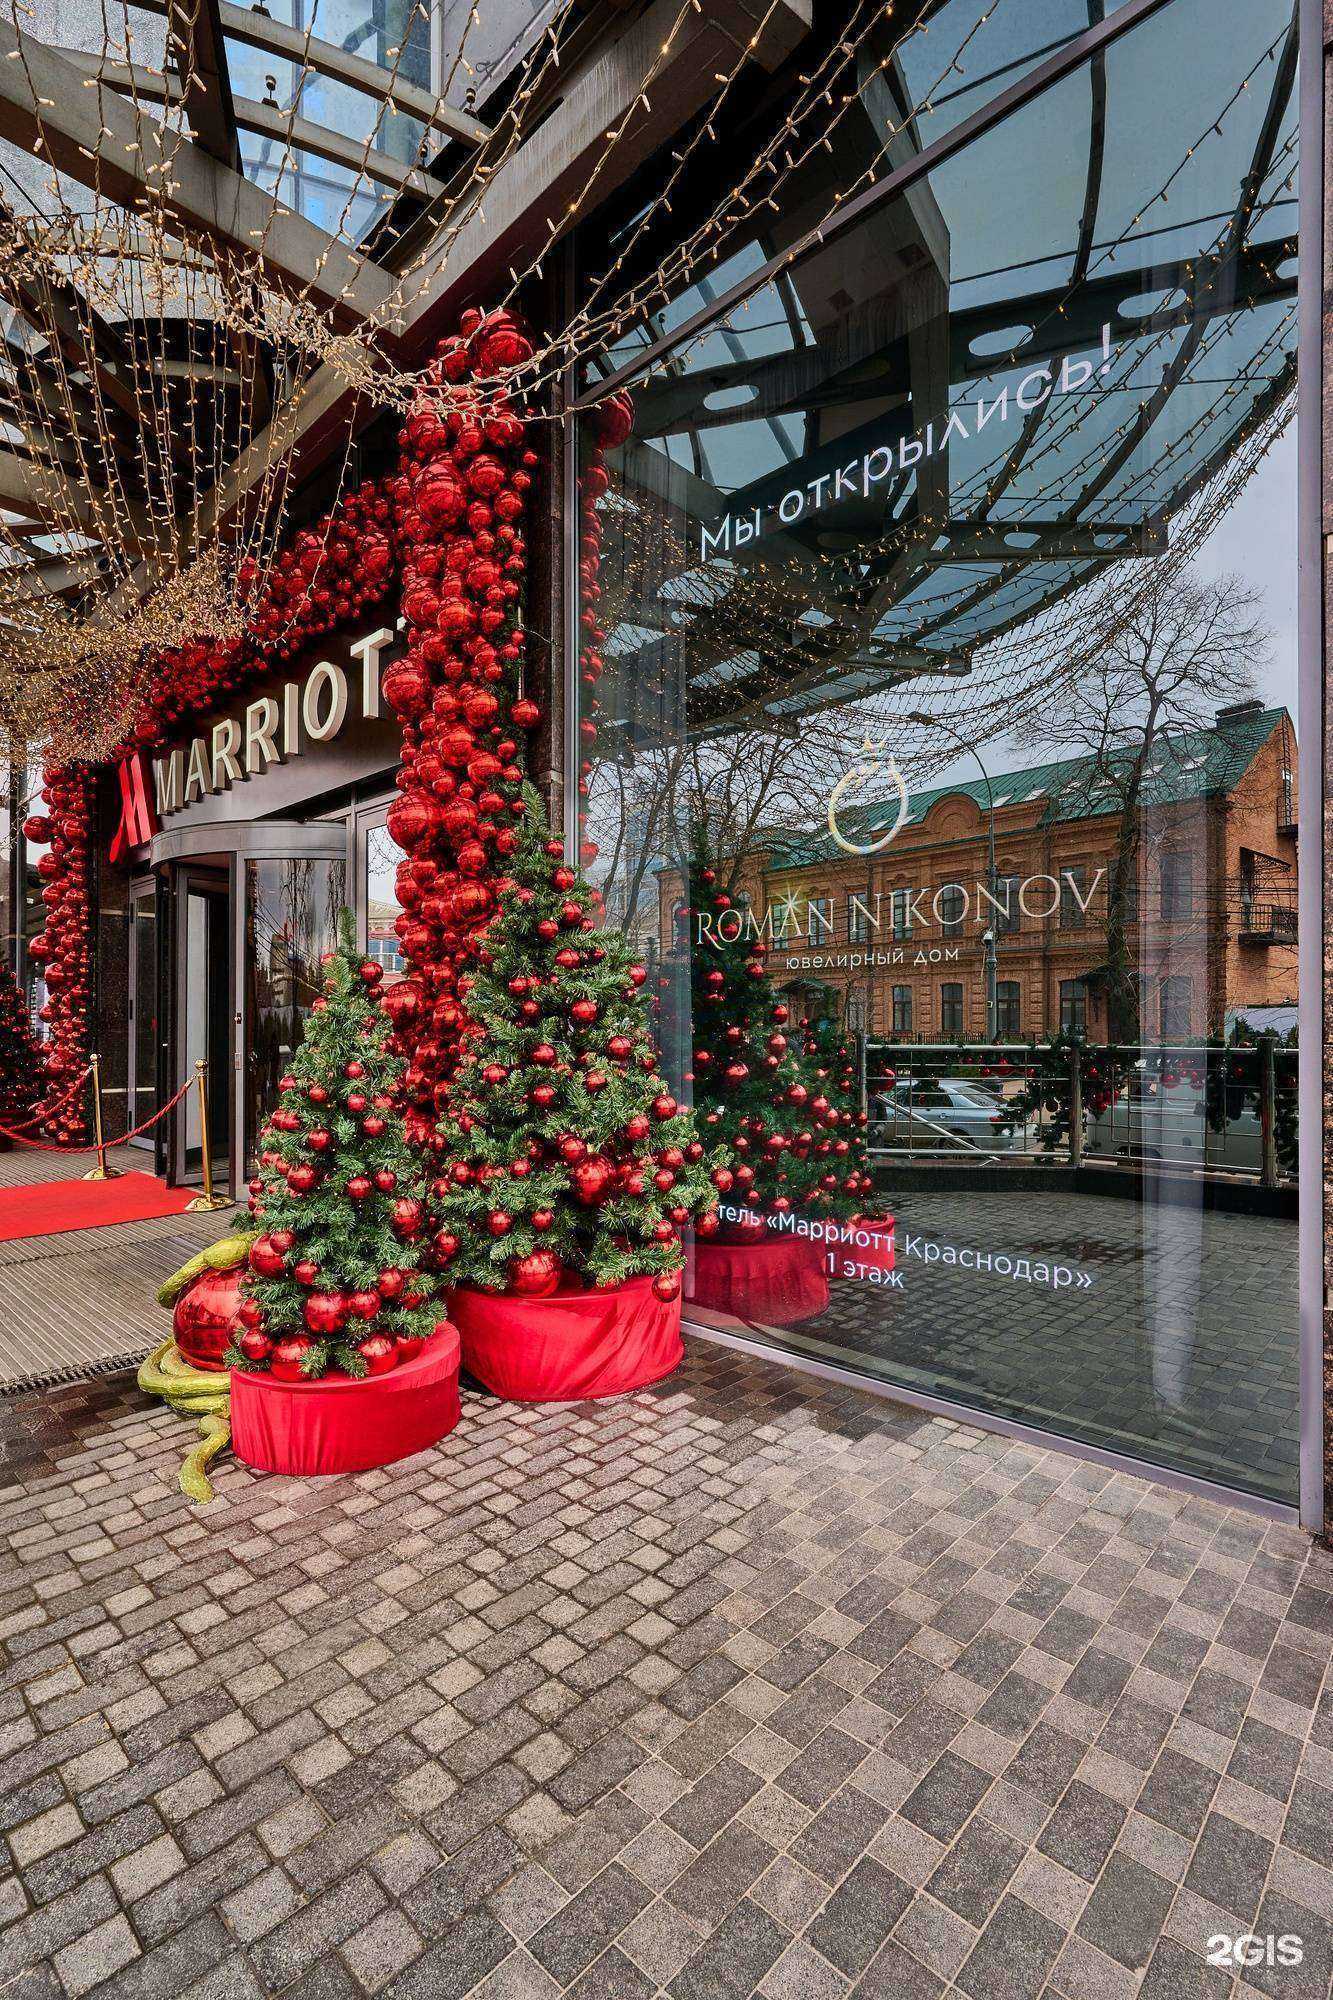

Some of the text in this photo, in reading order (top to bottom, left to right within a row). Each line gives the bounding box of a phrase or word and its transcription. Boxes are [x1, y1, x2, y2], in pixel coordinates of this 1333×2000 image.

[700, 322, 1112, 562] Мы открылись!
[153, 617, 407, 816] MARRIOT
[696, 868, 1108, 951] ROMAN NIKONOV
[785, 947, 960, 971] ювелирный дом
[718, 1203, 1094, 1290] тель «Марриотт Краснодар»
[826, 1252, 904, 1288] 1 этаж
